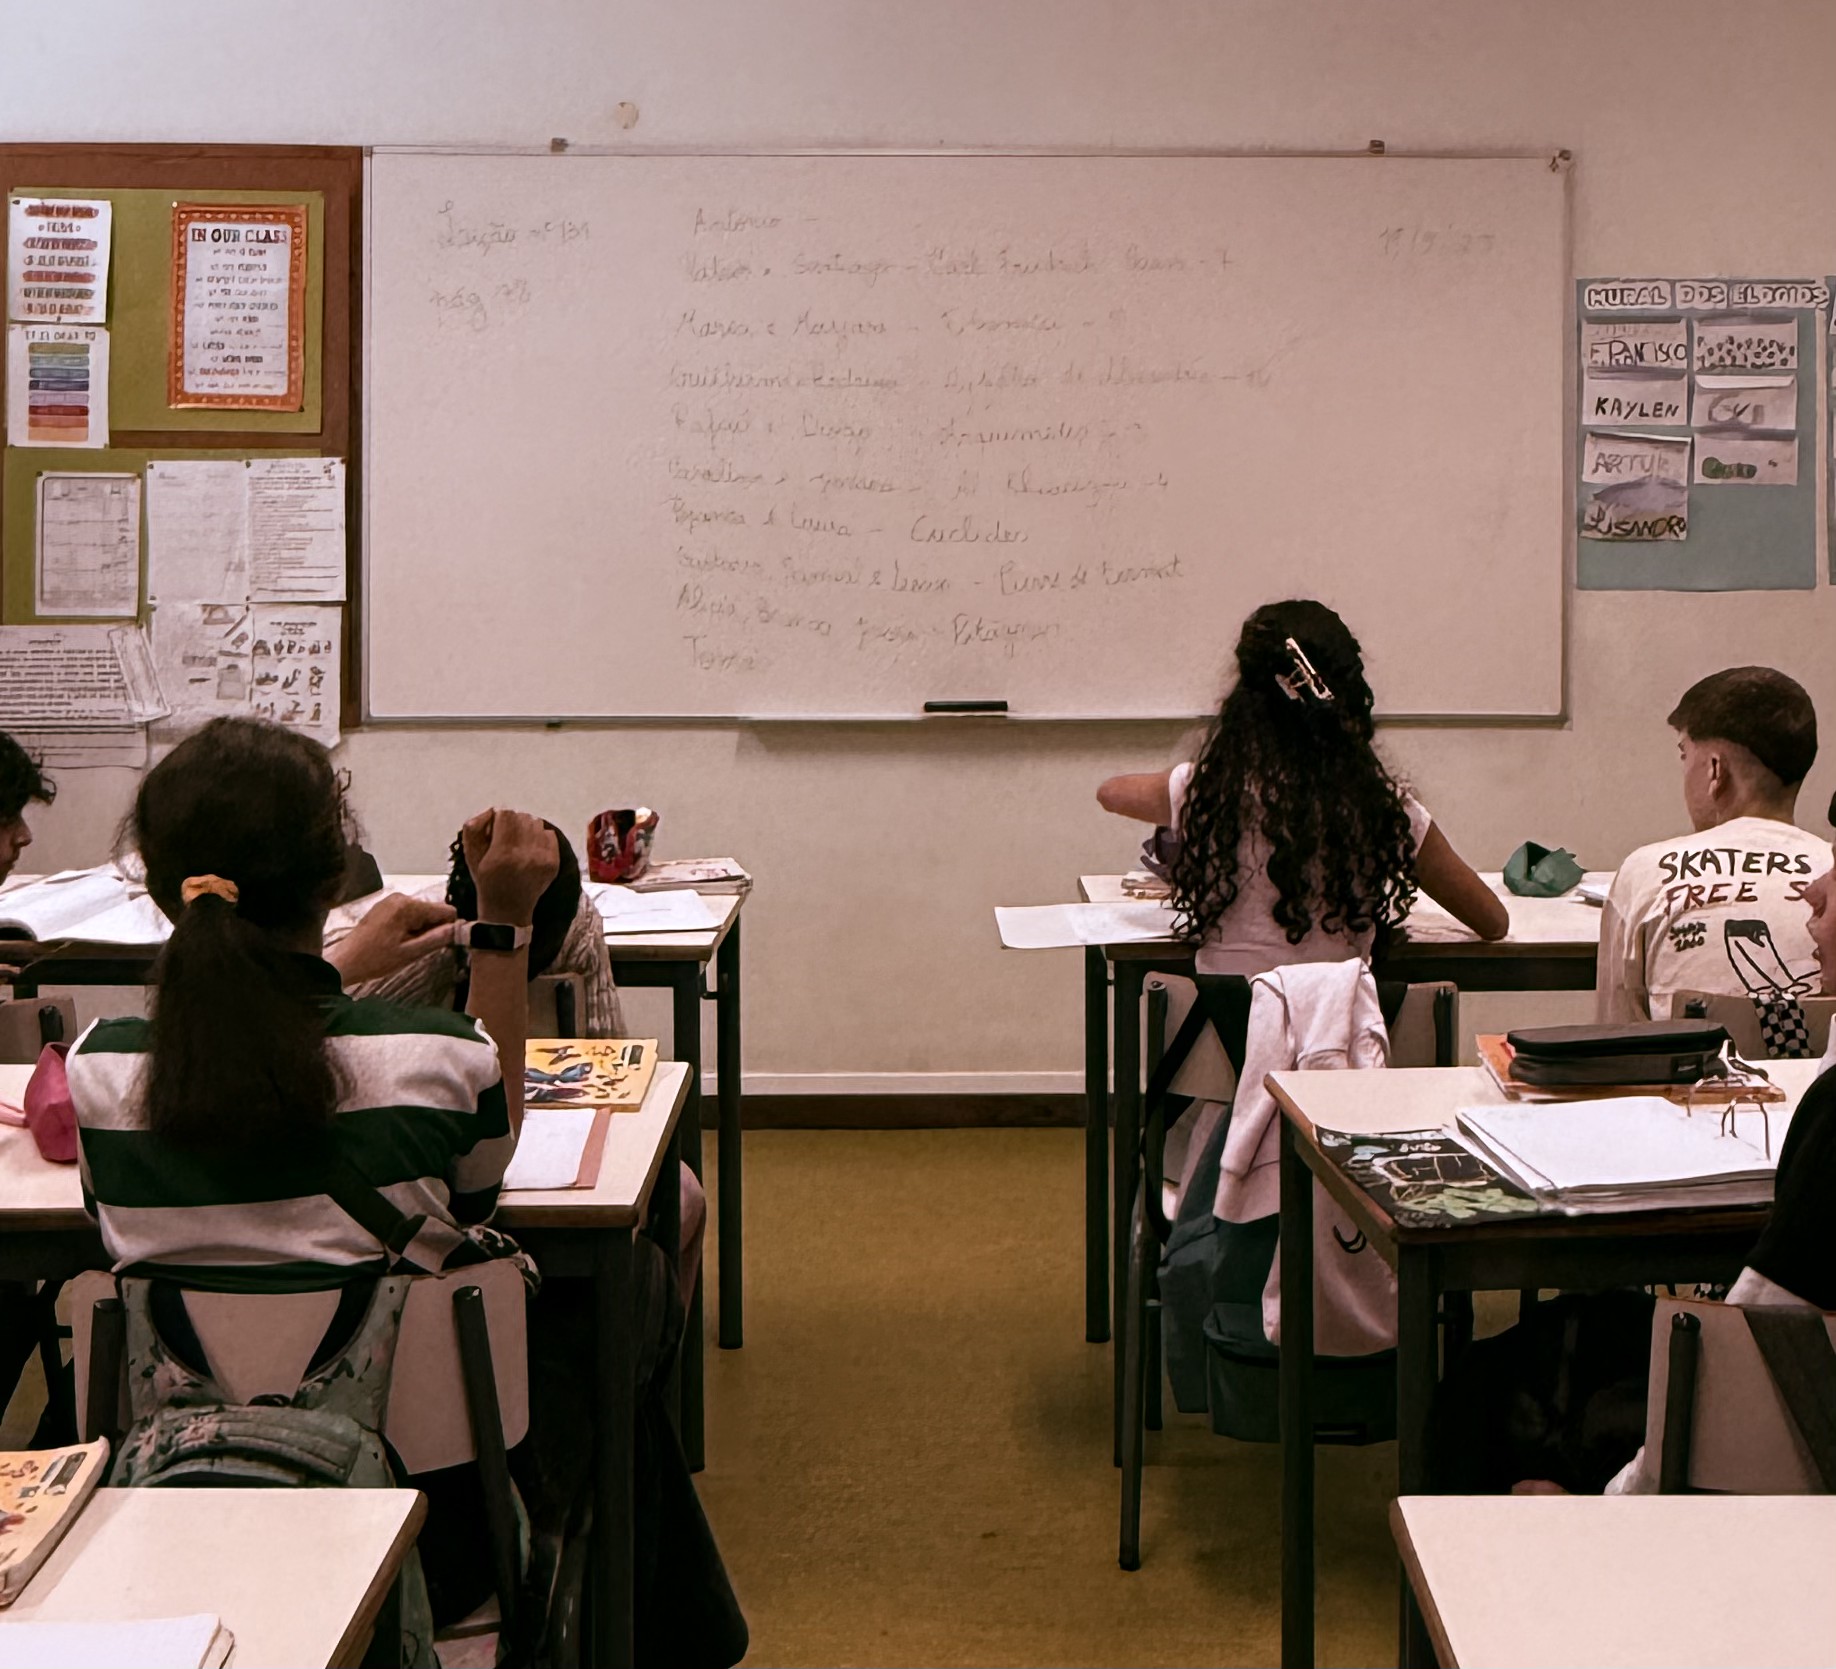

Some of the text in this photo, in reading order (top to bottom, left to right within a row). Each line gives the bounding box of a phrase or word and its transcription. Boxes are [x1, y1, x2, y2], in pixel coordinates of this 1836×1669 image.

[191, 228, 288, 243] IN OUR CLASS
[1587, 286, 1668, 306] MURAL
[1679, 284, 1726, 304] DOS
[1595, 396, 1680, 420] KAYLEN
[1659, 848, 1812, 885] SKATERS
[1664, 881, 1759, 917] FREE
